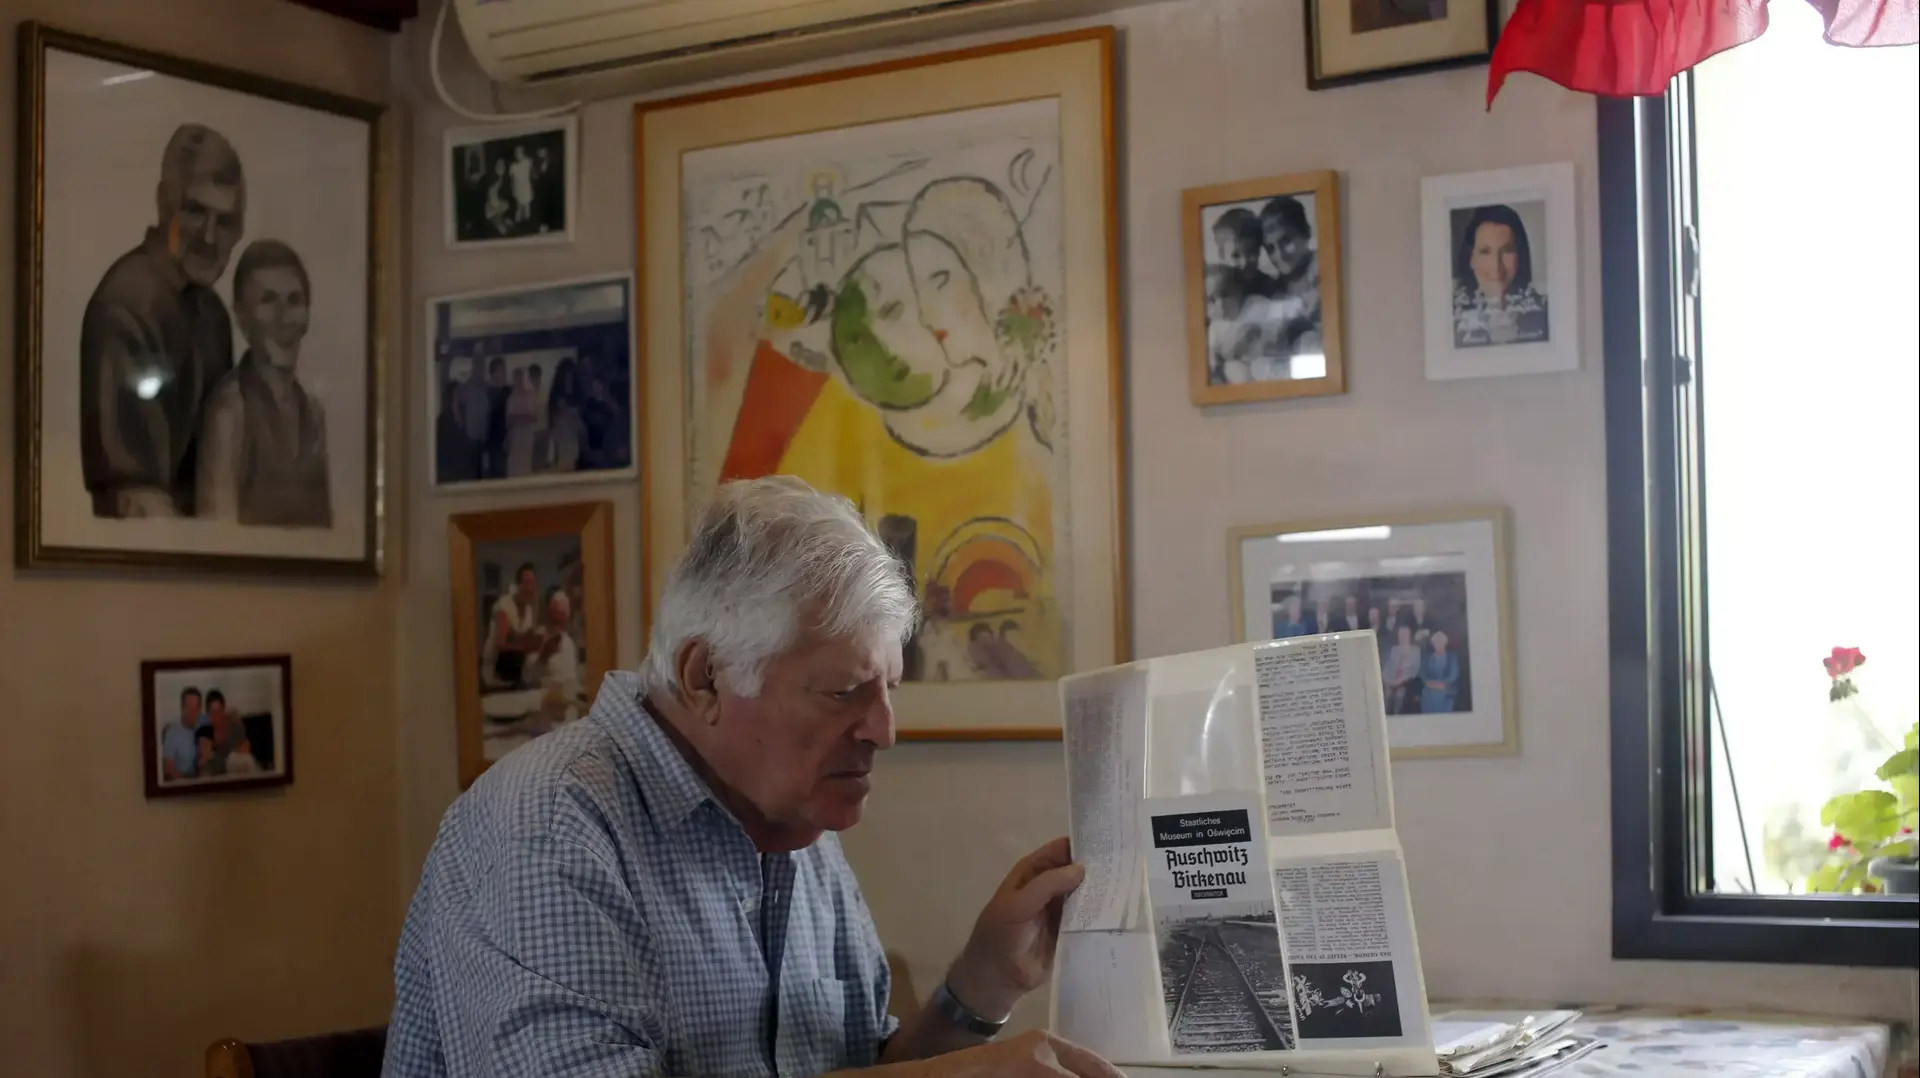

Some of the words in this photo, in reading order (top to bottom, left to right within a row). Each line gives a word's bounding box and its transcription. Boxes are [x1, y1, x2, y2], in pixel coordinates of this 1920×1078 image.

[1180, 818, 1221, 827] Staatliches
[1160, 832, 1192, 840] Museum
[1196, 830, 1203, 838] in
[1207, 827, 1244, 837] Oświęcim
[1165, 846, 1248, 870] Auschwitz
[1172, 870, 1246, 888] Birkenau
